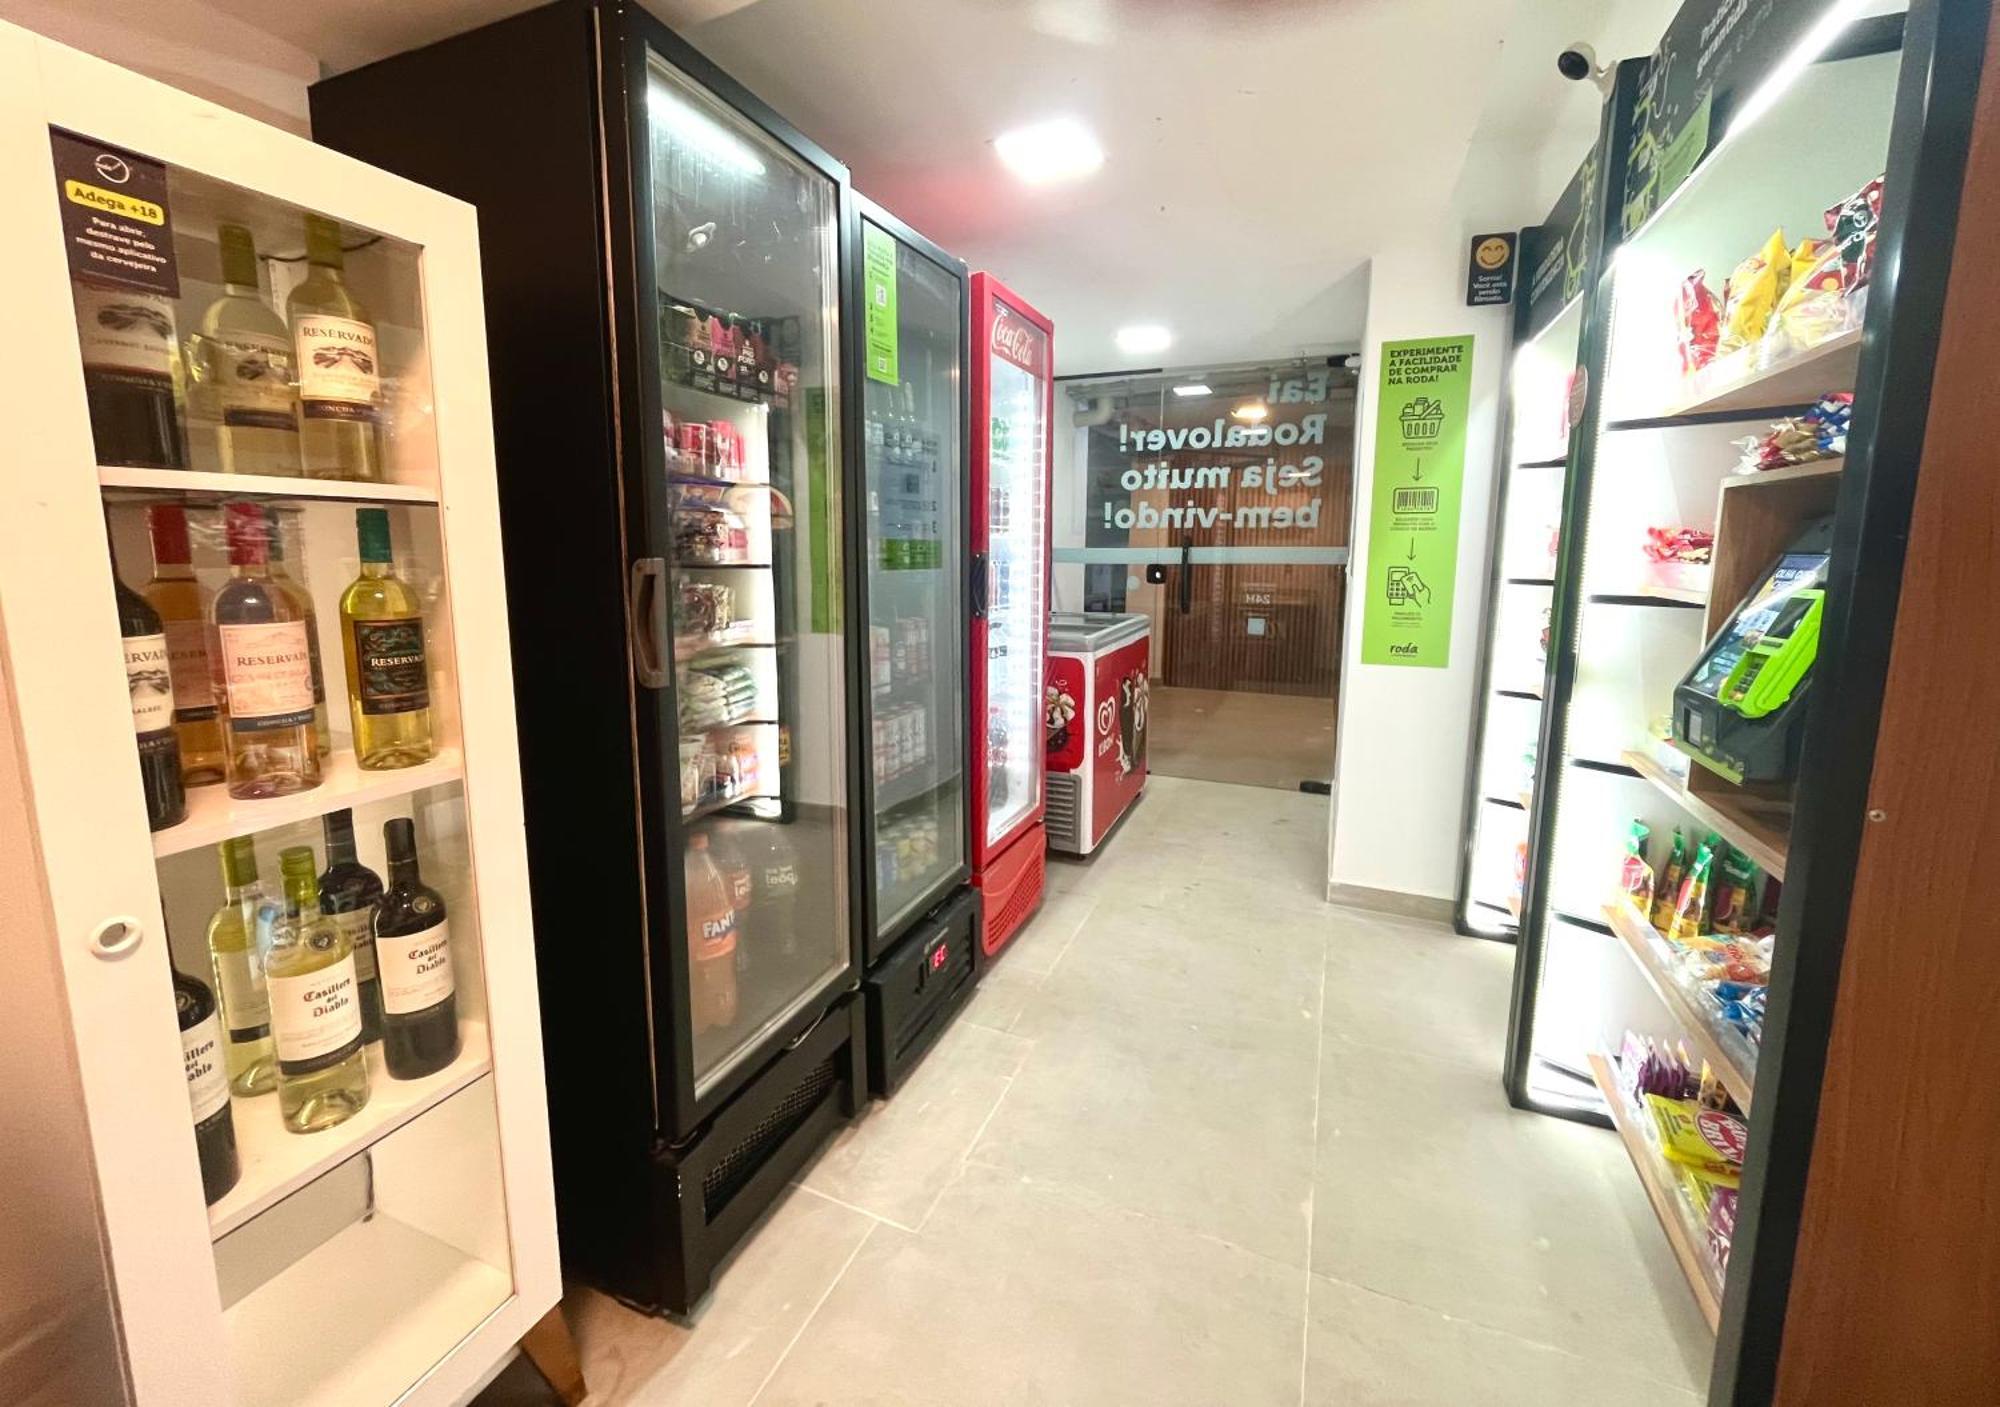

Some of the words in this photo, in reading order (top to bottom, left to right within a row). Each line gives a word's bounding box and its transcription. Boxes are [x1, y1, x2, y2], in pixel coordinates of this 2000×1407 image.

[74, 187, 125, 210] Adega
[131, 205, 157, 219] +18
[1390, 345, 1464, 358] EXPERIMENTE
[1399, 354, 1462, 366] FACILIDADE
[1389, 368, 1402, 376] DE
[1405, 364, 1458, 375] COMPRAR
[1388, 377, 1403, 385] NA
[1406, 375, 1439, 384] RODA!
[1390, 642, 1418, 654] roda
[702, 908, 736, 939] FANT
